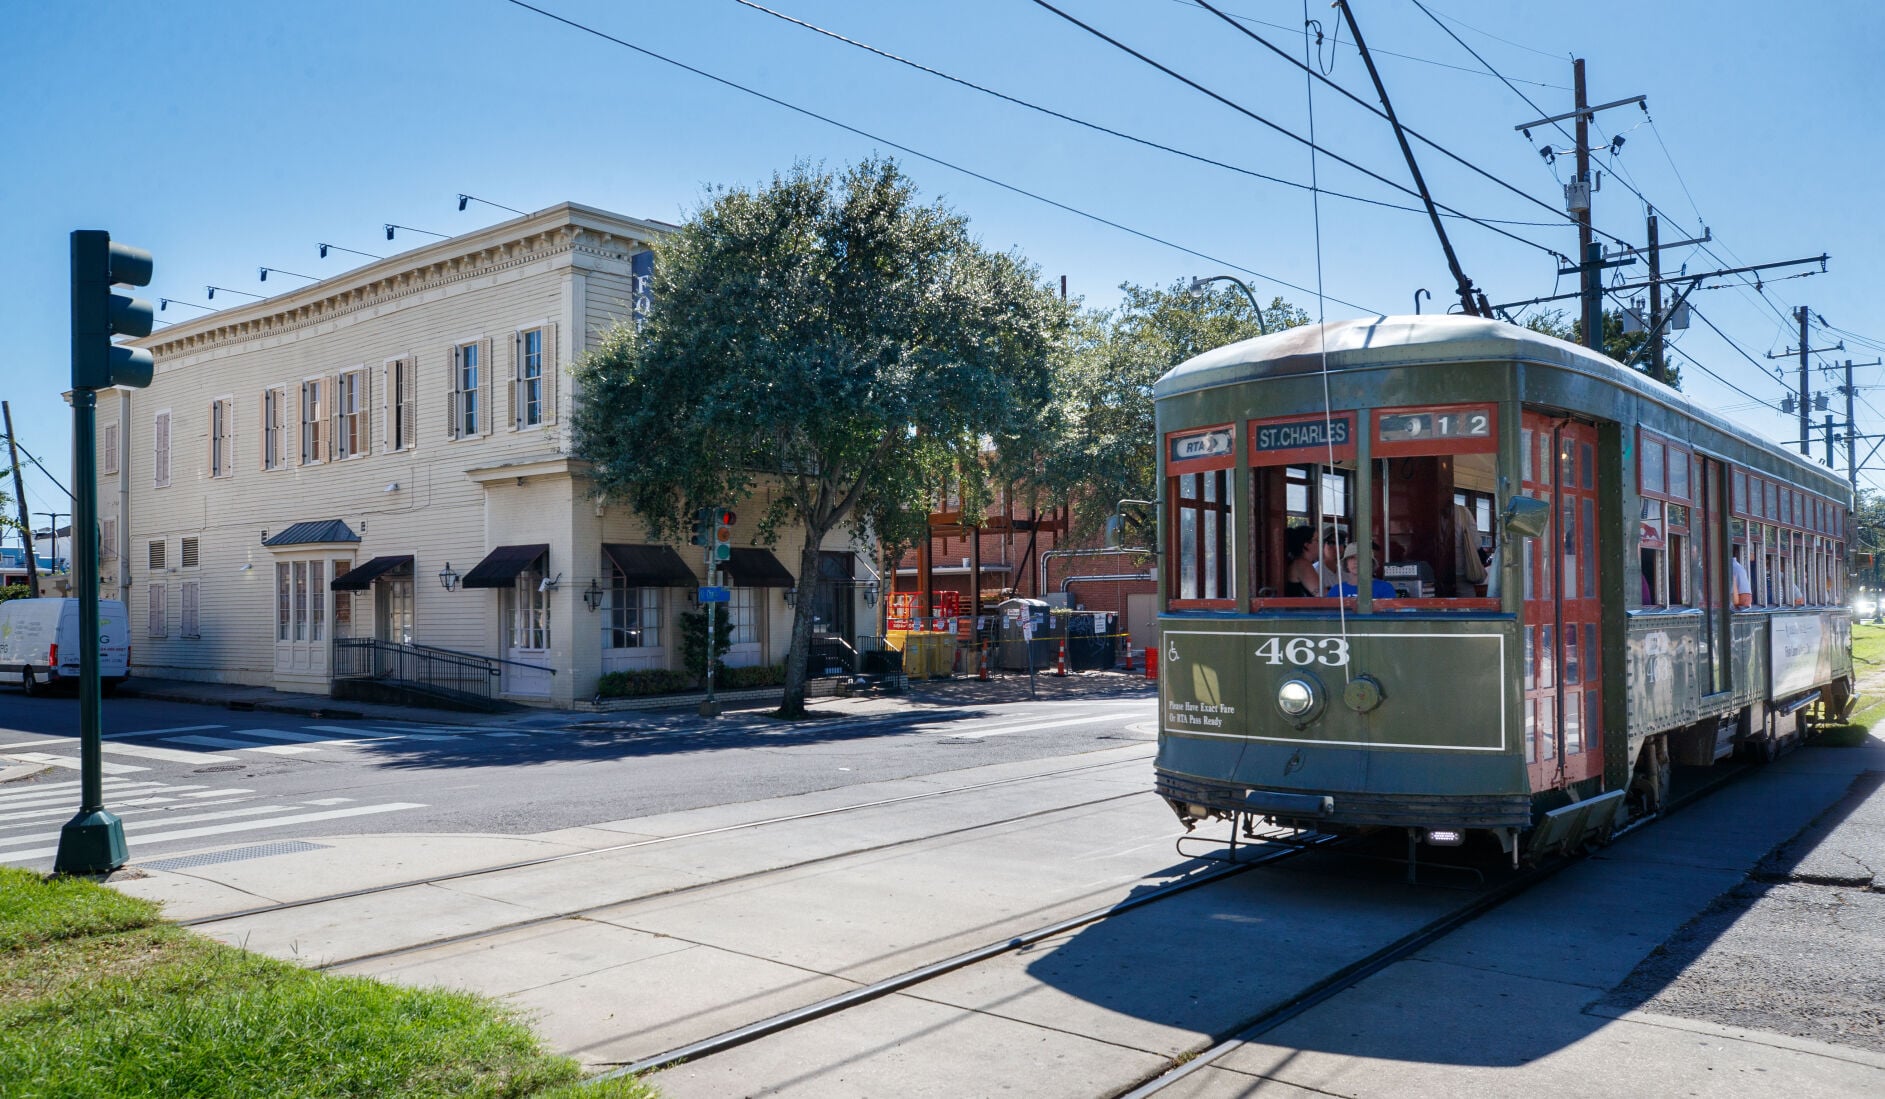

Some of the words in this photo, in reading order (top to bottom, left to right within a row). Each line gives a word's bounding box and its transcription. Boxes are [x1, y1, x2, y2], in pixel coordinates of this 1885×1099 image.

[1254, 637, 1350, 666] 463
[1169, 700, 1184, 710] Please
[1185, 701, 1198, 712] Have
[1200, 702, 1218, 713] Exact
[1220, 703, 1235, 714] Fare
[1169, 712, 1176, 722] Or
[1177, 713, 1188, 724] RTA
[1189, 714, 1201, 725] Pass
[1203, 715, 1223, 728] Ready
